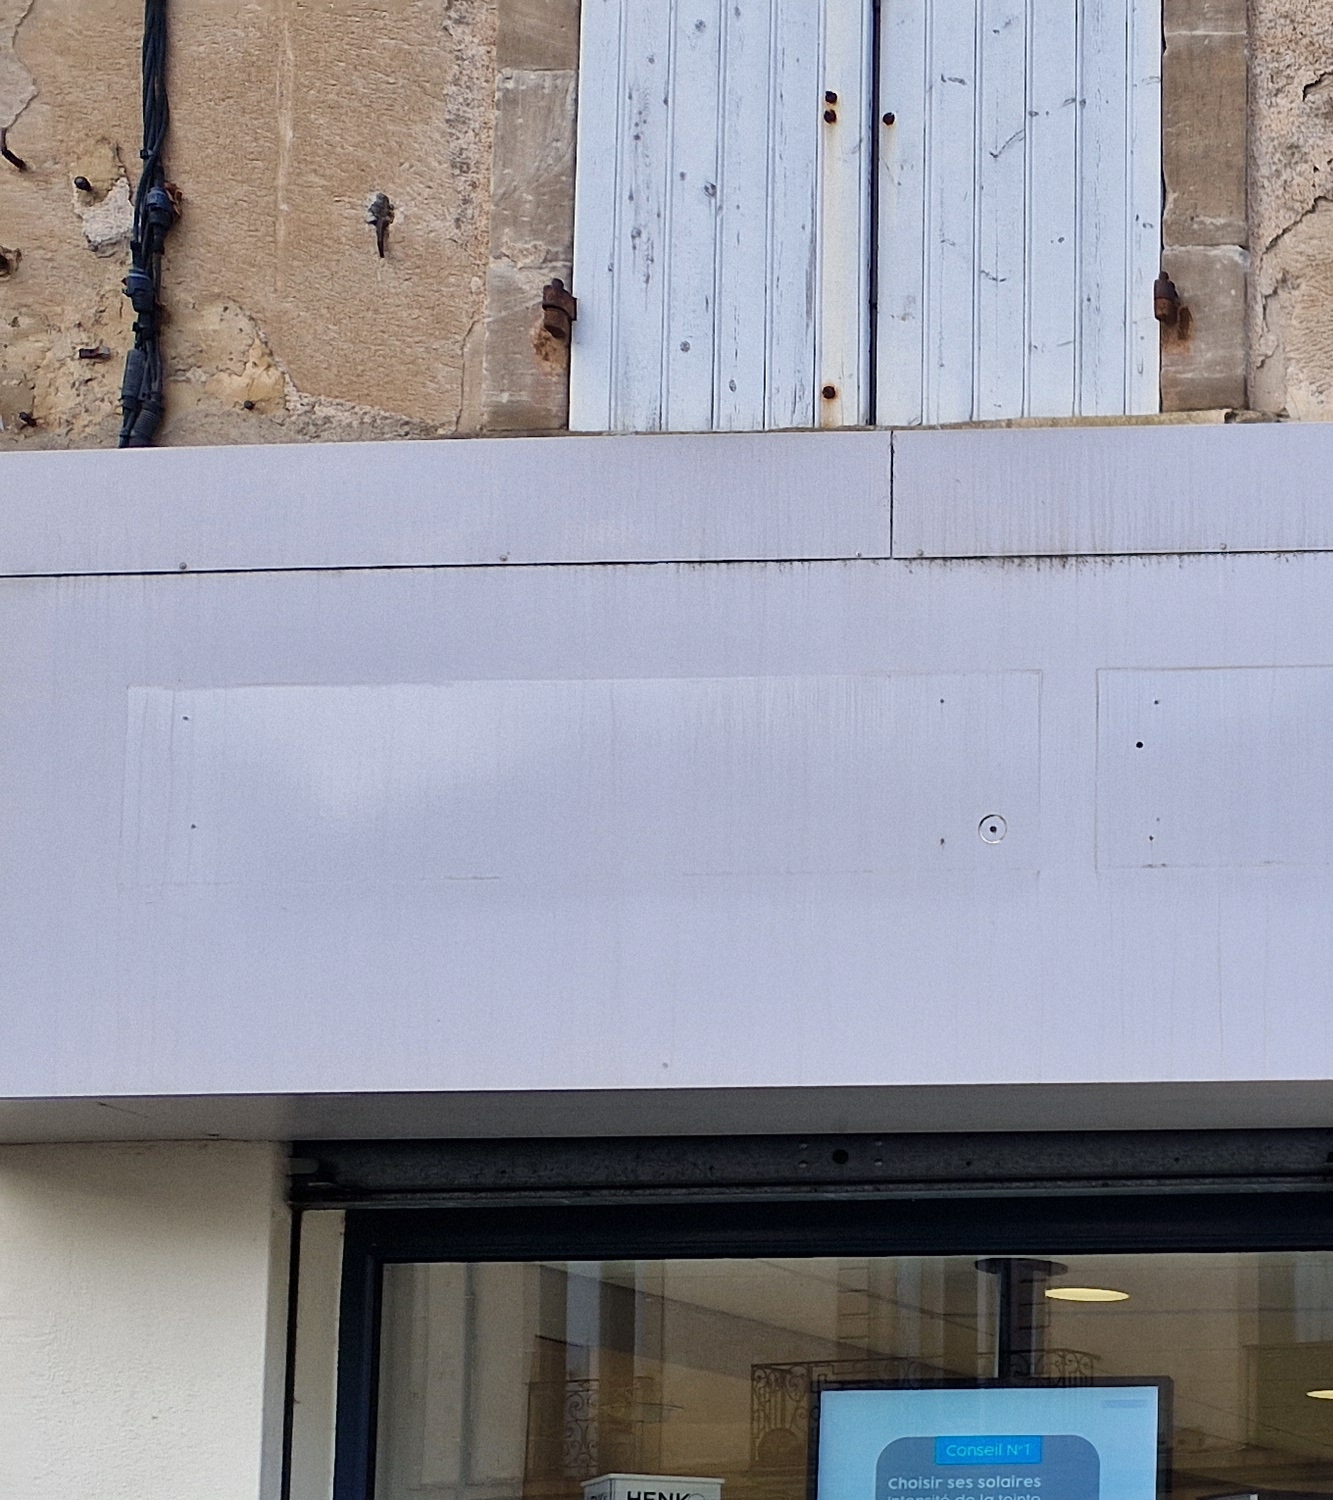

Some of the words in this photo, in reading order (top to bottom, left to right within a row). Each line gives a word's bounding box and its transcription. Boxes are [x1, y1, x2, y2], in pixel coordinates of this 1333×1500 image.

[946, 1443, 1001, 1457] Conseil
[888, 1475, 943, 1490] Choisir
[947, 1478, 973, 1489] ses
[977, 1475, 1042, 1488] solaires
